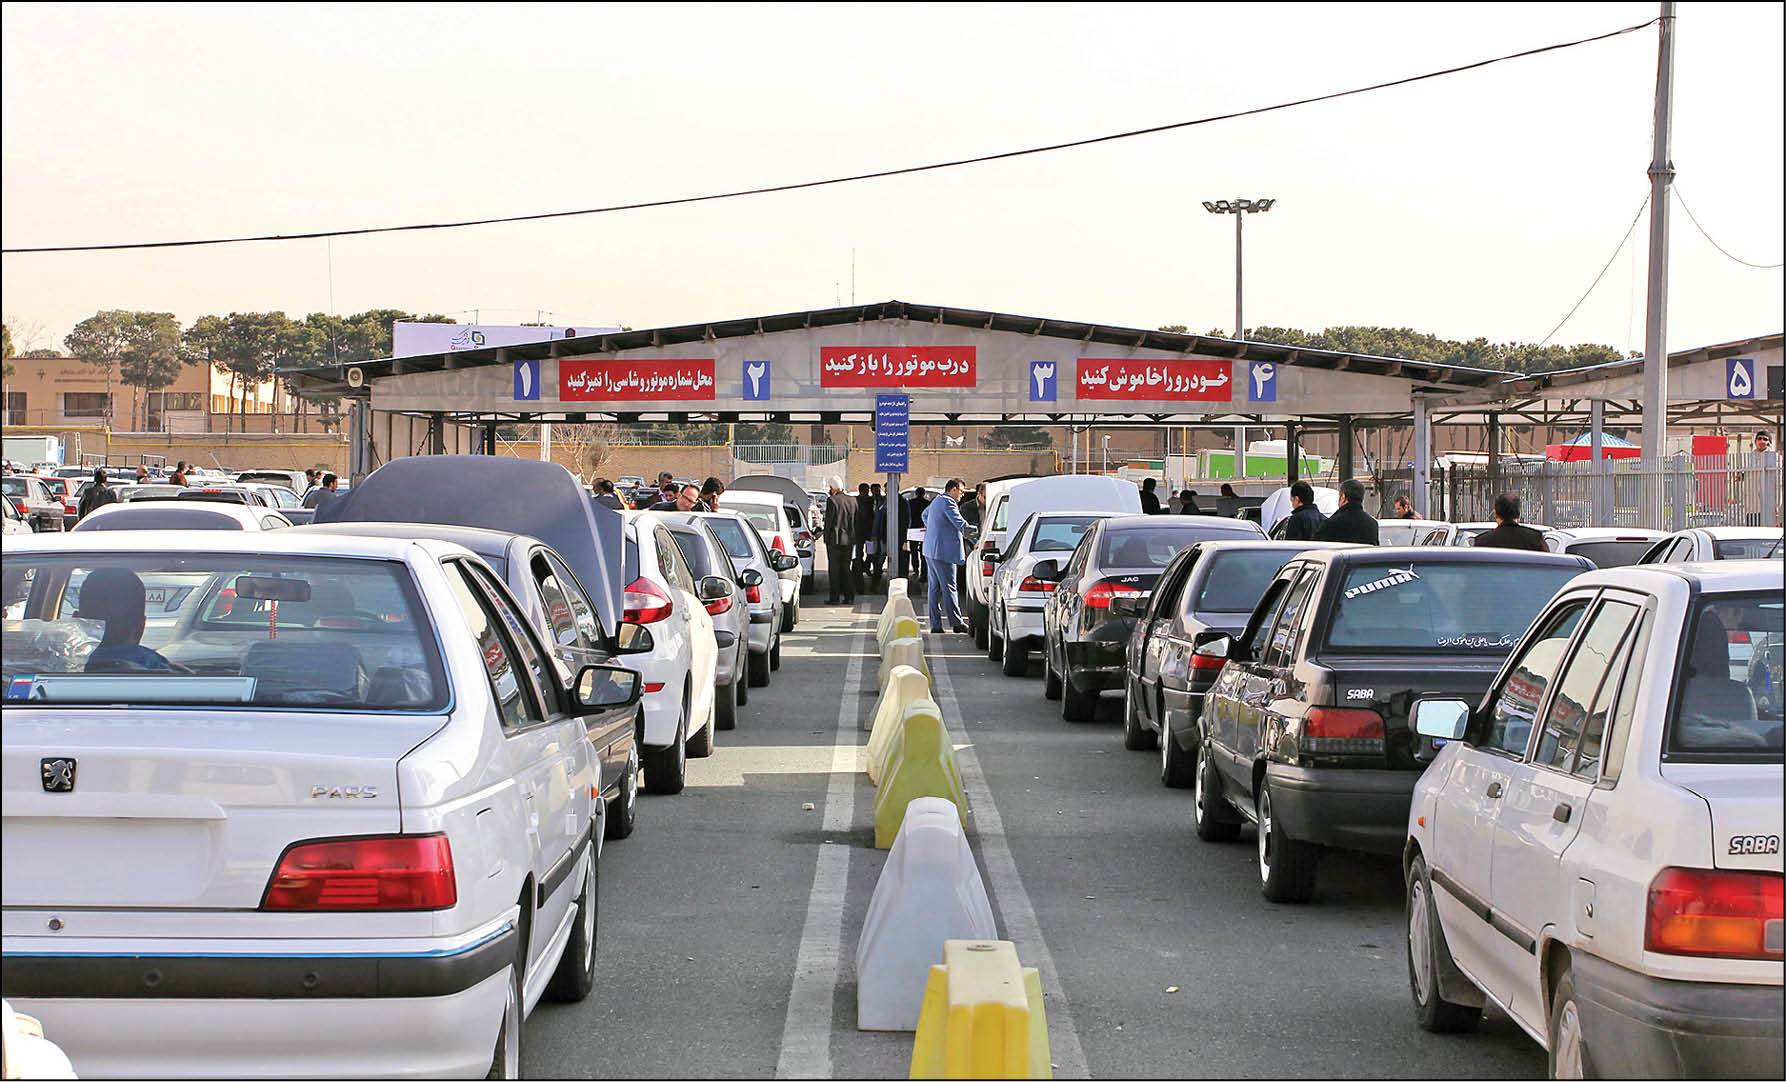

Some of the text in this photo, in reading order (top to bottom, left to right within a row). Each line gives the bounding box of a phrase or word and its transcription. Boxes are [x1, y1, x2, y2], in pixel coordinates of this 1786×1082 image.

[825, 353, 969, 376] درب موتور را باز کنید
[567, 370, 587, 391] کنید
[585, 371, 602, 392] تمیز
[605, 370, 612, 391] را
[613, 370, 640, 391] شاسی
[645, 371, 668, 392] موتور
[669, 370, 692, 390] شماره
[692, 369, 713, 390] محل
[747, 362, 765, 398] ۲
[1033, 363, 1054, 398] ۳
[1080, 365, 1110, 390] کنید
[1109, 366, 1163, 391] خاموش
[1164, 366, 1174, 391] را
[1252, 363, 1274, 398] ۴
[1730, 360, 1751, 396] ۵
[1344, 573, 1413, 599] PUMA
[1346, 688, 1374, 699] SABA
[312, 784, 377, 799] PARS
[1728, 835, 1780, 855] SABA
